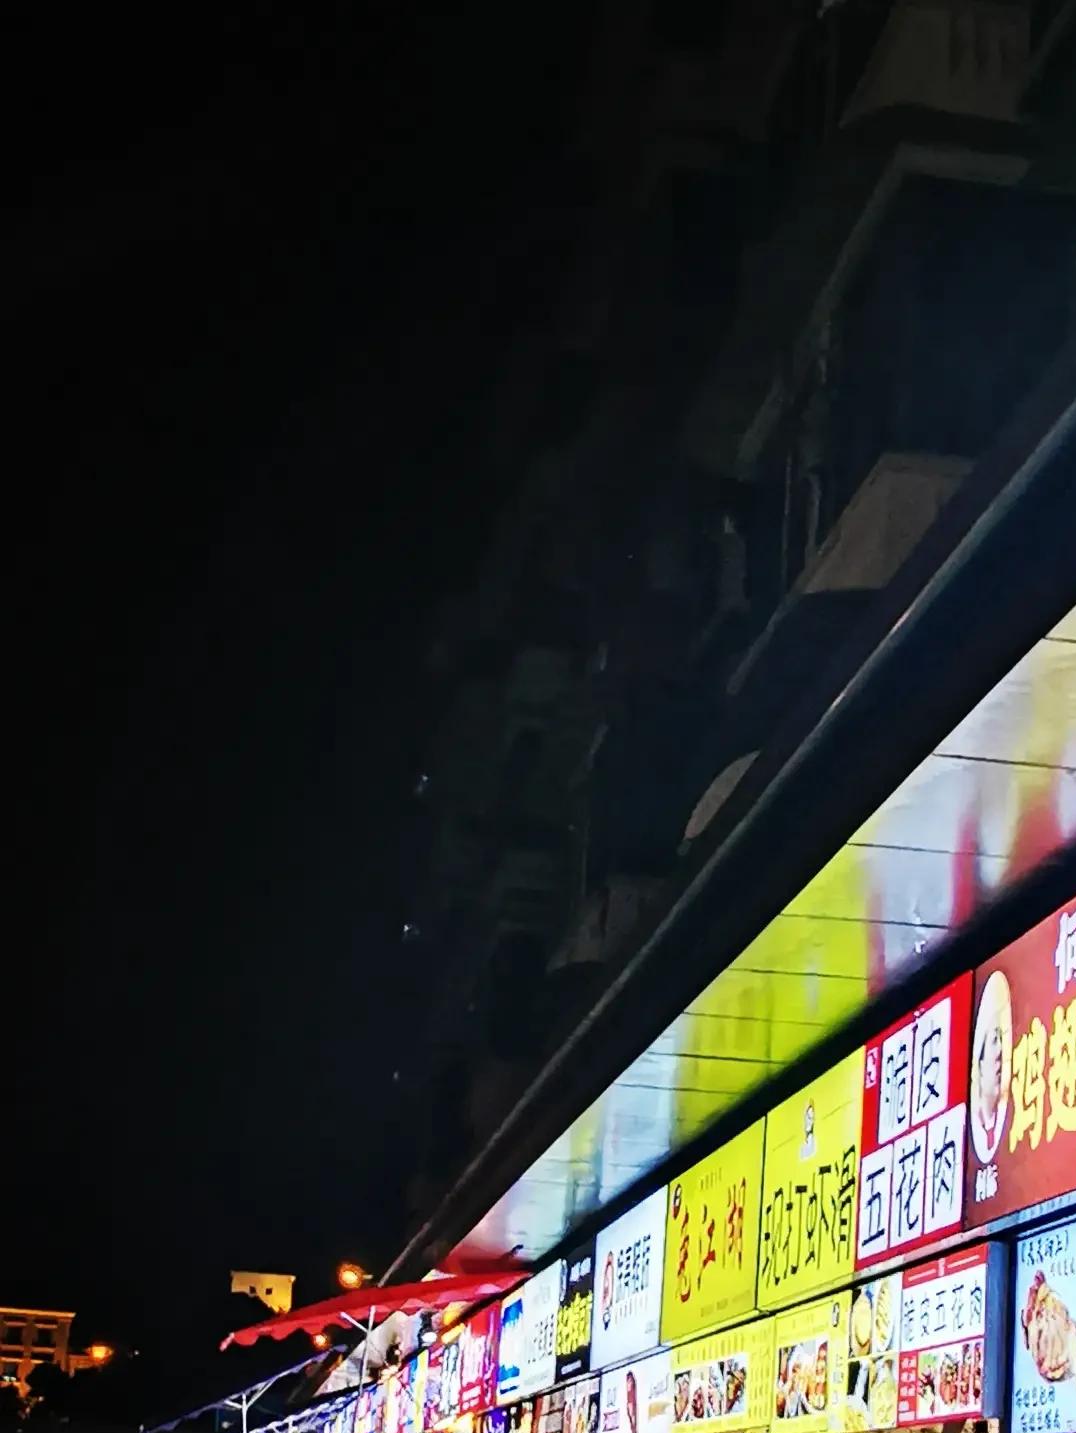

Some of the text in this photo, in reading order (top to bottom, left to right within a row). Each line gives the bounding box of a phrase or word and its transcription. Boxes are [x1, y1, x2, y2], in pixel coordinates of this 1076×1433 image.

[760, 1144, 858, 1290] 现打虾滑
[860, 1124, 958, 1248] 五花肉
